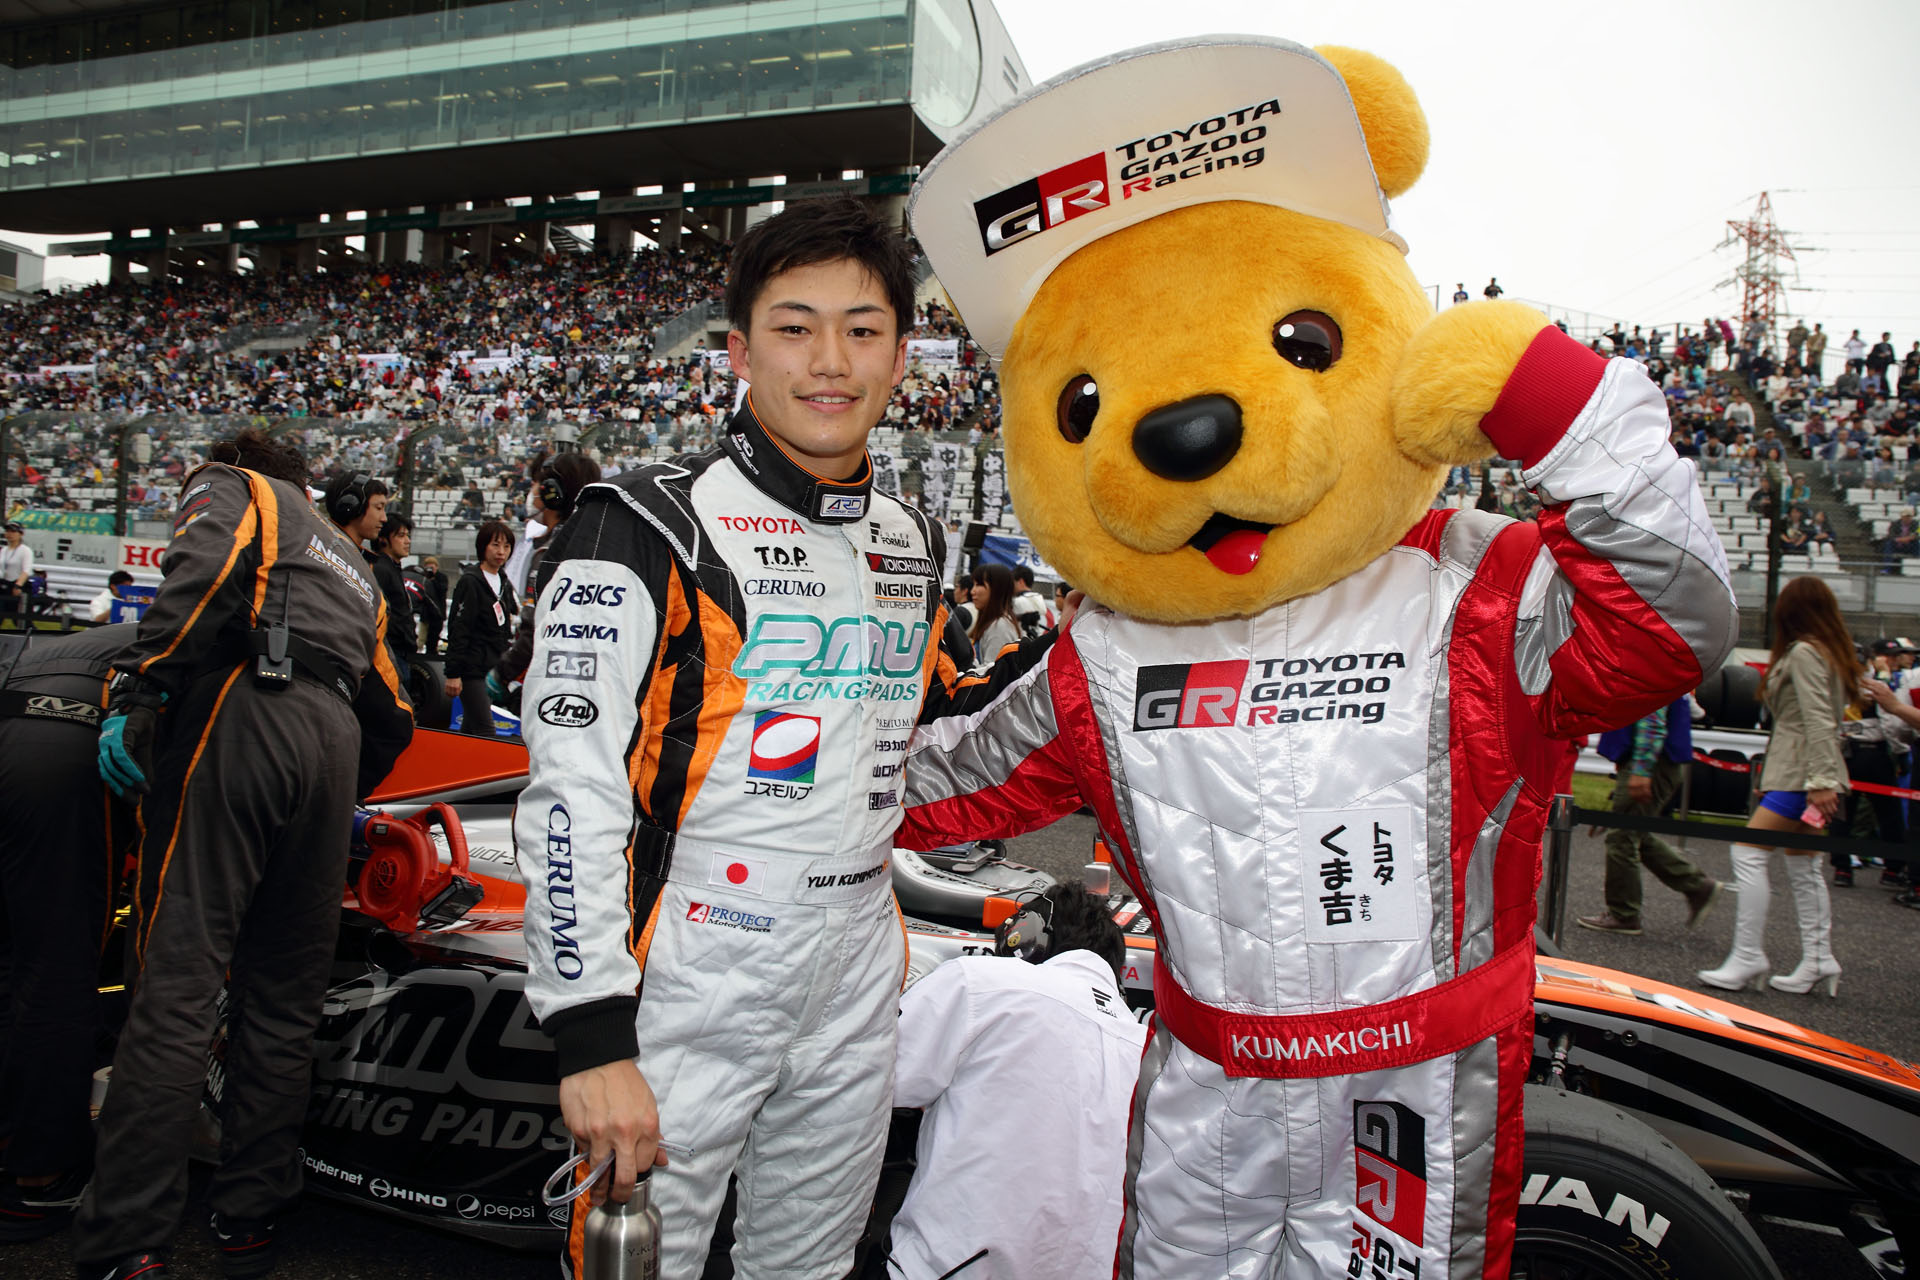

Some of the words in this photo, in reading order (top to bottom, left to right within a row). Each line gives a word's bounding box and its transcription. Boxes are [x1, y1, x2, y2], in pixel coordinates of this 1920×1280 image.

[1115, 98, 1281, 162] TOYOTA
[1120, 125, 1267, 181] GAZOO
[1122, 147, 1265, 200] Racing
[986, 179, 1107, 250] GR
[827, 499, 862, 510] ARD
[718, 516, 806, 535] TOYOTA
[881, 536, 911, 549] FORMULA
[308, 533, 375, 601] INGING
[881, 556, 933, 576] YOKOHAMA
[568, 584, 627, 607] asics
[744, 578, 826, 598] CERUMO
[875, 581, 923, 598] INGING
[548, 654, 595, 678] asa
[1255, 652, 1406, 679] TOYOTA
[744, 680, 870, 702] RACING
[871, 681, 918, 702] PADS
[1250, 676, 1391, 702] GAZOO
[540, 696, 592, 720] Arai
[1137, 685, 1237, 729] GR
[1248, 700, 1386, 727] Racing
[1373, 821, 1394, 886] トヨタ
[807, 874, 836, 888] YUJI
[1318, 824, 1356, 926] くま吉
[547, 803, 584, 981] CERUMO
[711, 906, 776, 928] PROJECT
[1358, 893, 1373, 922] きち
[707, 917, 739, 929] Motor
[740, 923, 771, 934] Sports
[1231, 1020, 1412, 1061] KUMAKICHI
[1356, 1103, 1398, 1223] GR
[393, 1187, 448, 1208] HINO
[484, 1202, 535, 1220] pepsi
